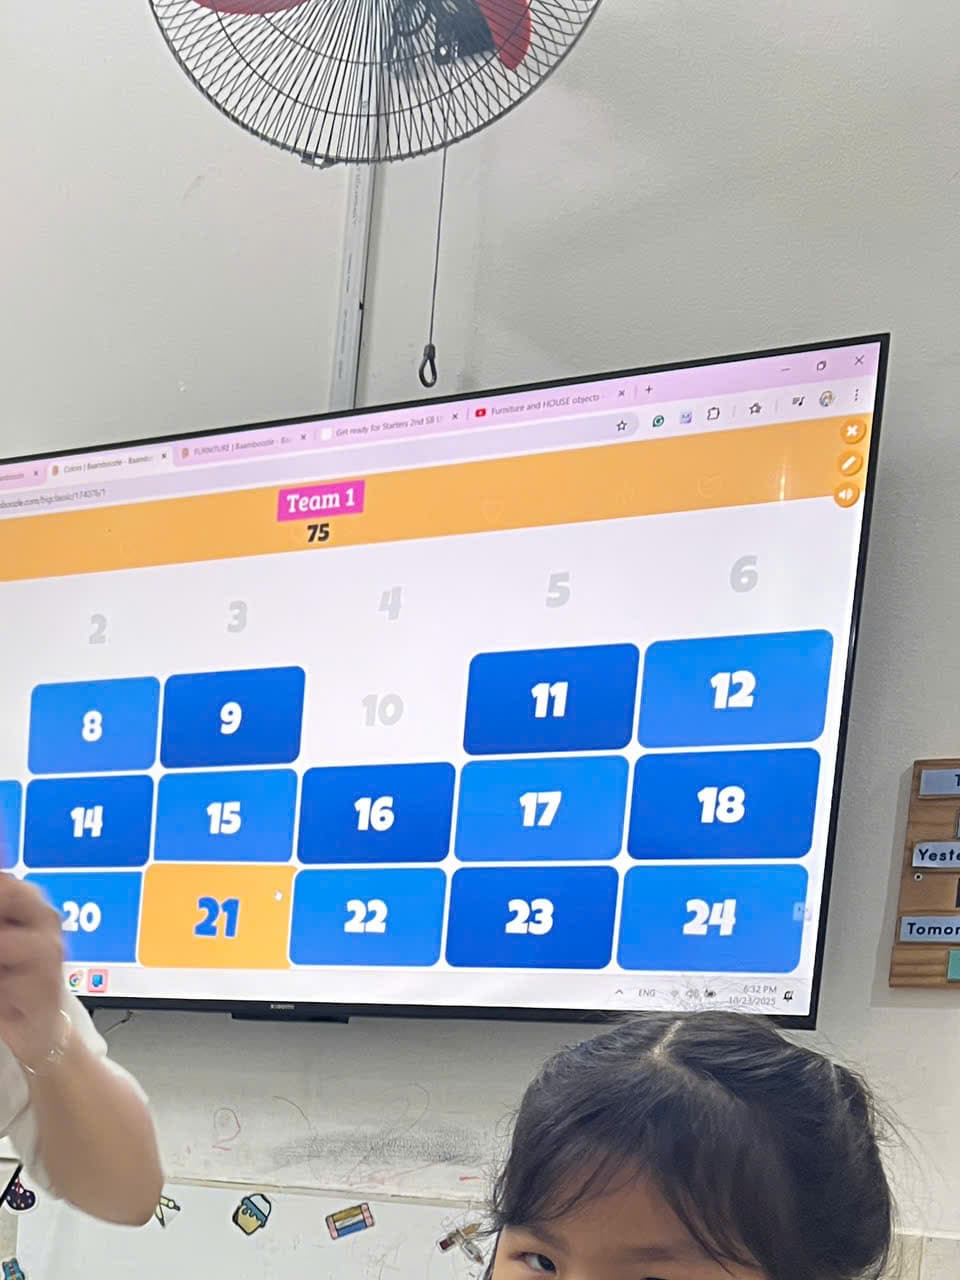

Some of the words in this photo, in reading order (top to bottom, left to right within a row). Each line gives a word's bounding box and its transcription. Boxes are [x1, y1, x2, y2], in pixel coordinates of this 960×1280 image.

[526, 401, 541, 411] and
[542, 396, 570, 408] HOUSE
[336, 427, 348, 437] Get
[370, 424, 380, 432] for
[286, 491, 341, 513] Team
[345, 487, 356, 507] 1
[306, 523, 330, 543] 75
[545, 571, 571, 608] 5
[729, 555, 758, 593] 6
[227, 600, 248, 633] 3
[378, 586, 402, 621] 4
[88, 614, 107, 645] 2
[531, 681, 569, 718] 11
[710, 670, 756, 710] 12
[81, 710, 103, 742] 8
[219, 701, 242, 735] 9
[361, 694, 404, 727] 10
[70, 805, 104, 838] 14
[206, 801, 242, 835] 15
[354, 795, 395, 832] 16
[519, 790, 562, 827] 17
[697, 785, 746, 824] 18
[62, 901, 102, 932] 20
[193, 896, 241, 938] 21
[343, 899, 388, 934] 22
[505, 898, 554, 935] 23
[682, 898, 737, 936] 24
[638, 989, 656, 998] ENG
[763, 984, 778, 994] PM
